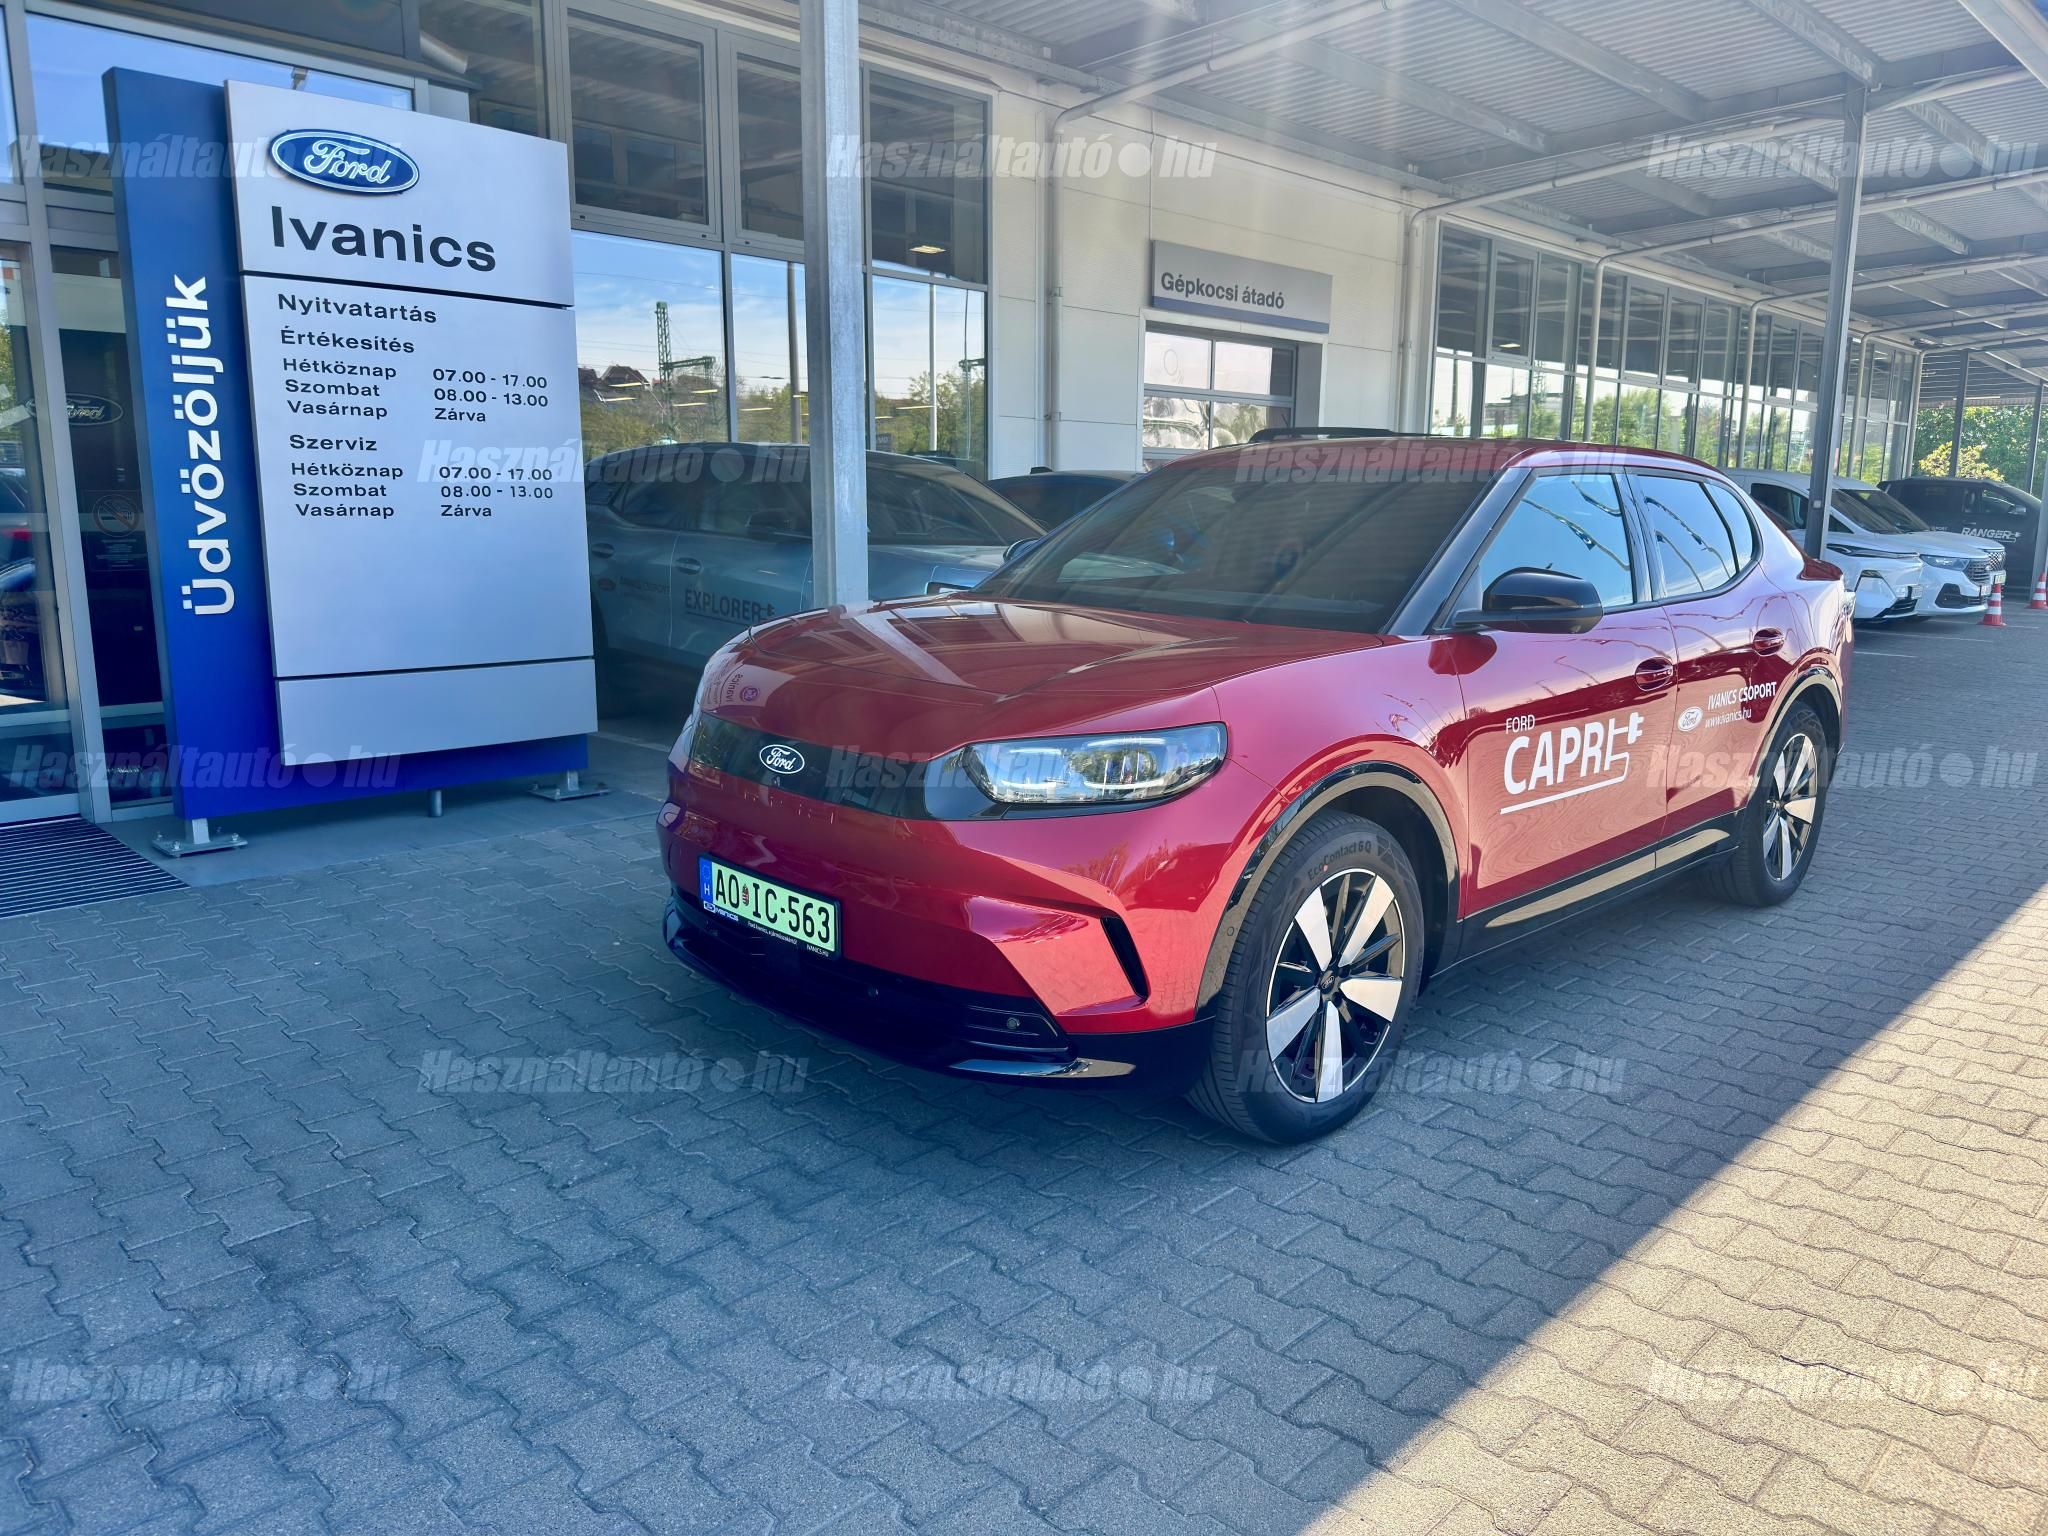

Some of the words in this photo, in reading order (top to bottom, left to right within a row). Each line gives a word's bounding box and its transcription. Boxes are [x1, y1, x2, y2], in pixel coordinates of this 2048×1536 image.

[303, 139, 392, 185] Ford
[271, 205, 497, 273] Ivanics
[1161, 271, 1239, 302] Gépkocsi
[1241, 286, 1285, 310] átadó
[277, 293, 438, 324] Nyitvatartás
[280, 325, 416, 354] Értékesítés
[282, 357, 398, 380] Hétköznap
[432, 368, 486, 384] 07.00
[502, 374, 548, 389] 17.00
[284, 379, 381, 397] Szombat
[433, 388, 487, 403] 08.00
[503, 392, 549, 408] 13.00
[287, 399, 388, 418] Vasárnap
[434, 407, 487, 422] Zárva
[165, 273, 236, 615] Üdvözöljük
[289, 434, 378, 452] Szerviz
[291, 462, 404, 480] Hétköznap
[438, 466, 492, 480] 07.00
[507, 468, 553, 481] 17.00
[293, 482, 388, 497] Szombat
[440, 485, 492, 498] 08.00
[509, 485, 554, 499] 13.00
[295, 503, 395, 520] Vasárnap
[440, 503, 493, 518] Zárva
[1961, 527, 2013, 540] RANGER
[684, 588, 762, 622] EXPLORER
[1707, 688, 1738, 711] IVANICS
[1738, 681, 1777, 702] CSOPORT
[1505, 714, 1536, 735] FORD
[1704, 706, 1752, 729] www.ivanics.hu
[766, 747, 797, 771] Ford
[1503, 717, 1618, 796] CAPRI
[703, 882, 711, 896] H
[715, 868, 740, 910] AO
[752, 882, 831, 944] IC-563
